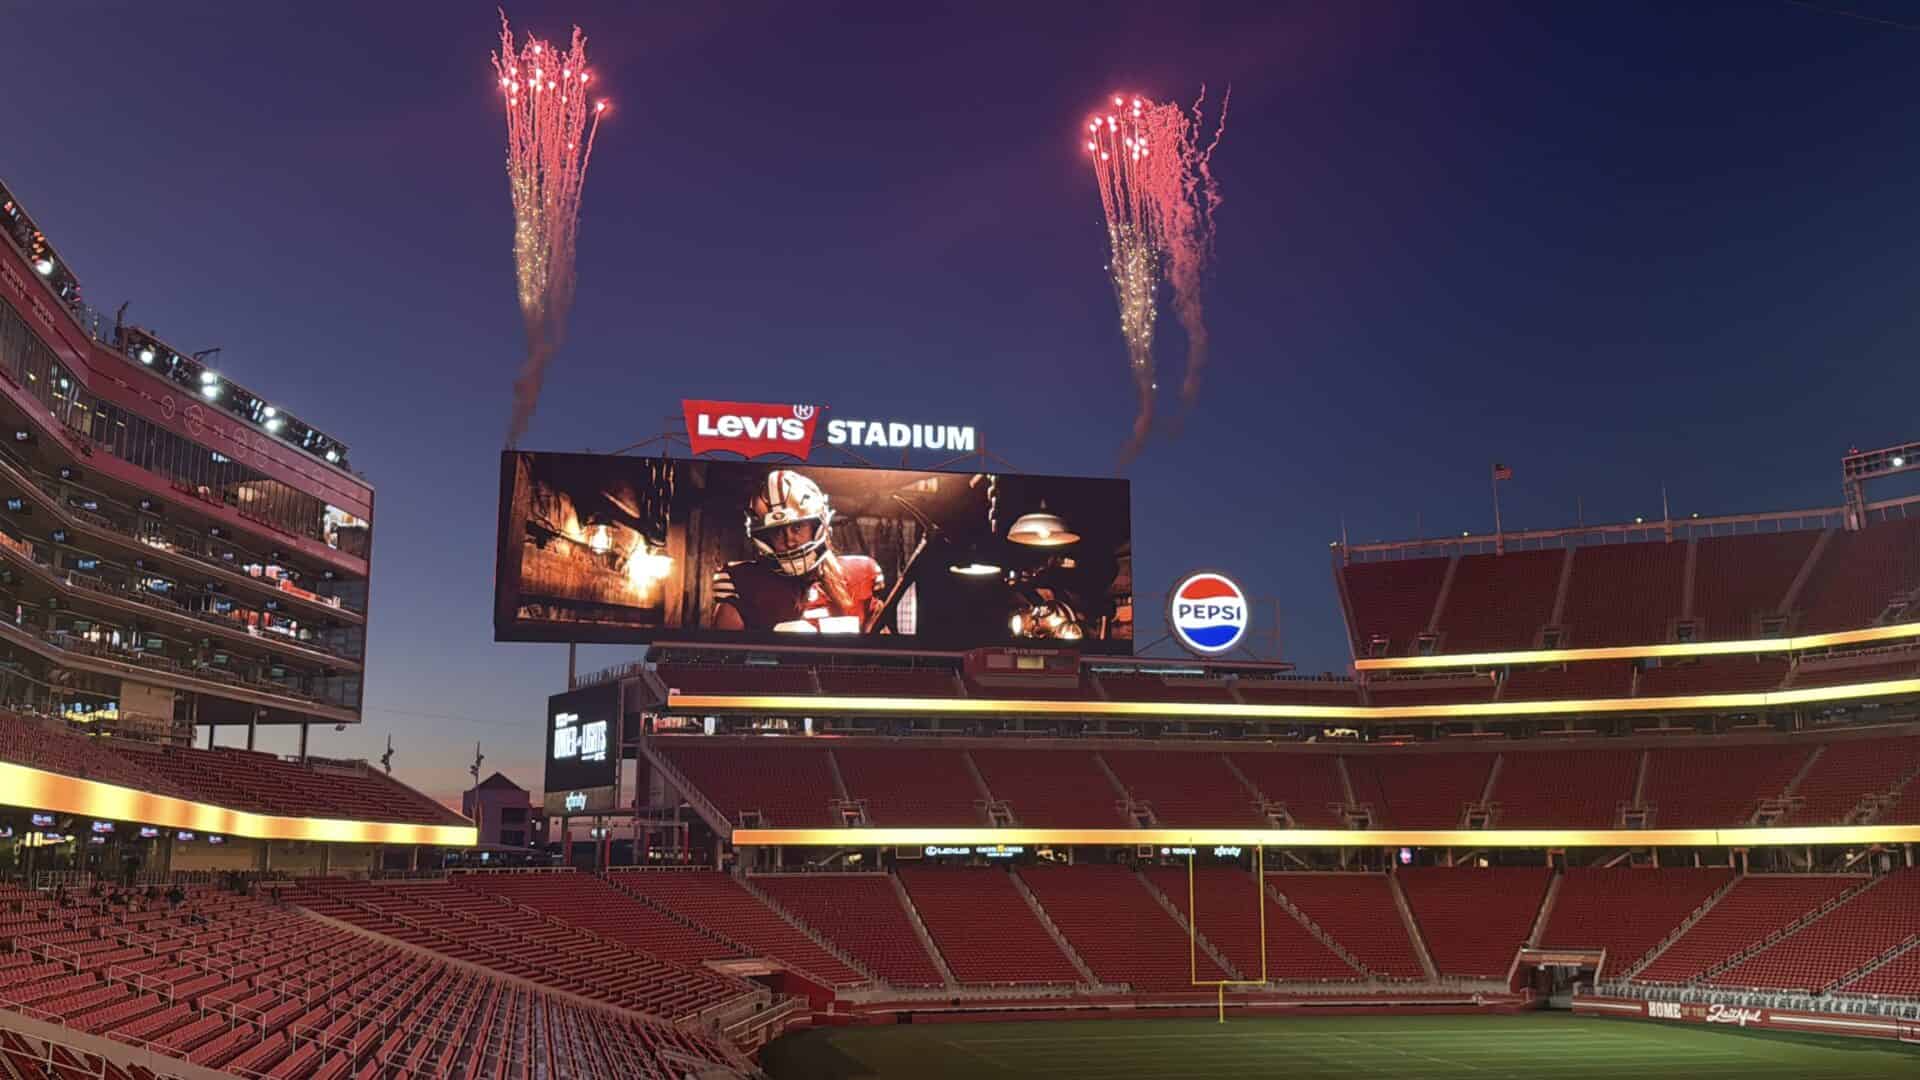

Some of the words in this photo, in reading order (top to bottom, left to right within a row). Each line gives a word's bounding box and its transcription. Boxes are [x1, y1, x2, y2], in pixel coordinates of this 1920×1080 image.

[827, 419, 975, 450] STADIUM
[1179, 604, 1241, 621] PEPSI
[938, 847, 970, 855] LEXUS
[1648, 1001, 1681, 1018] HOME
[1706, 1004, 1762, 1026] Faithful
